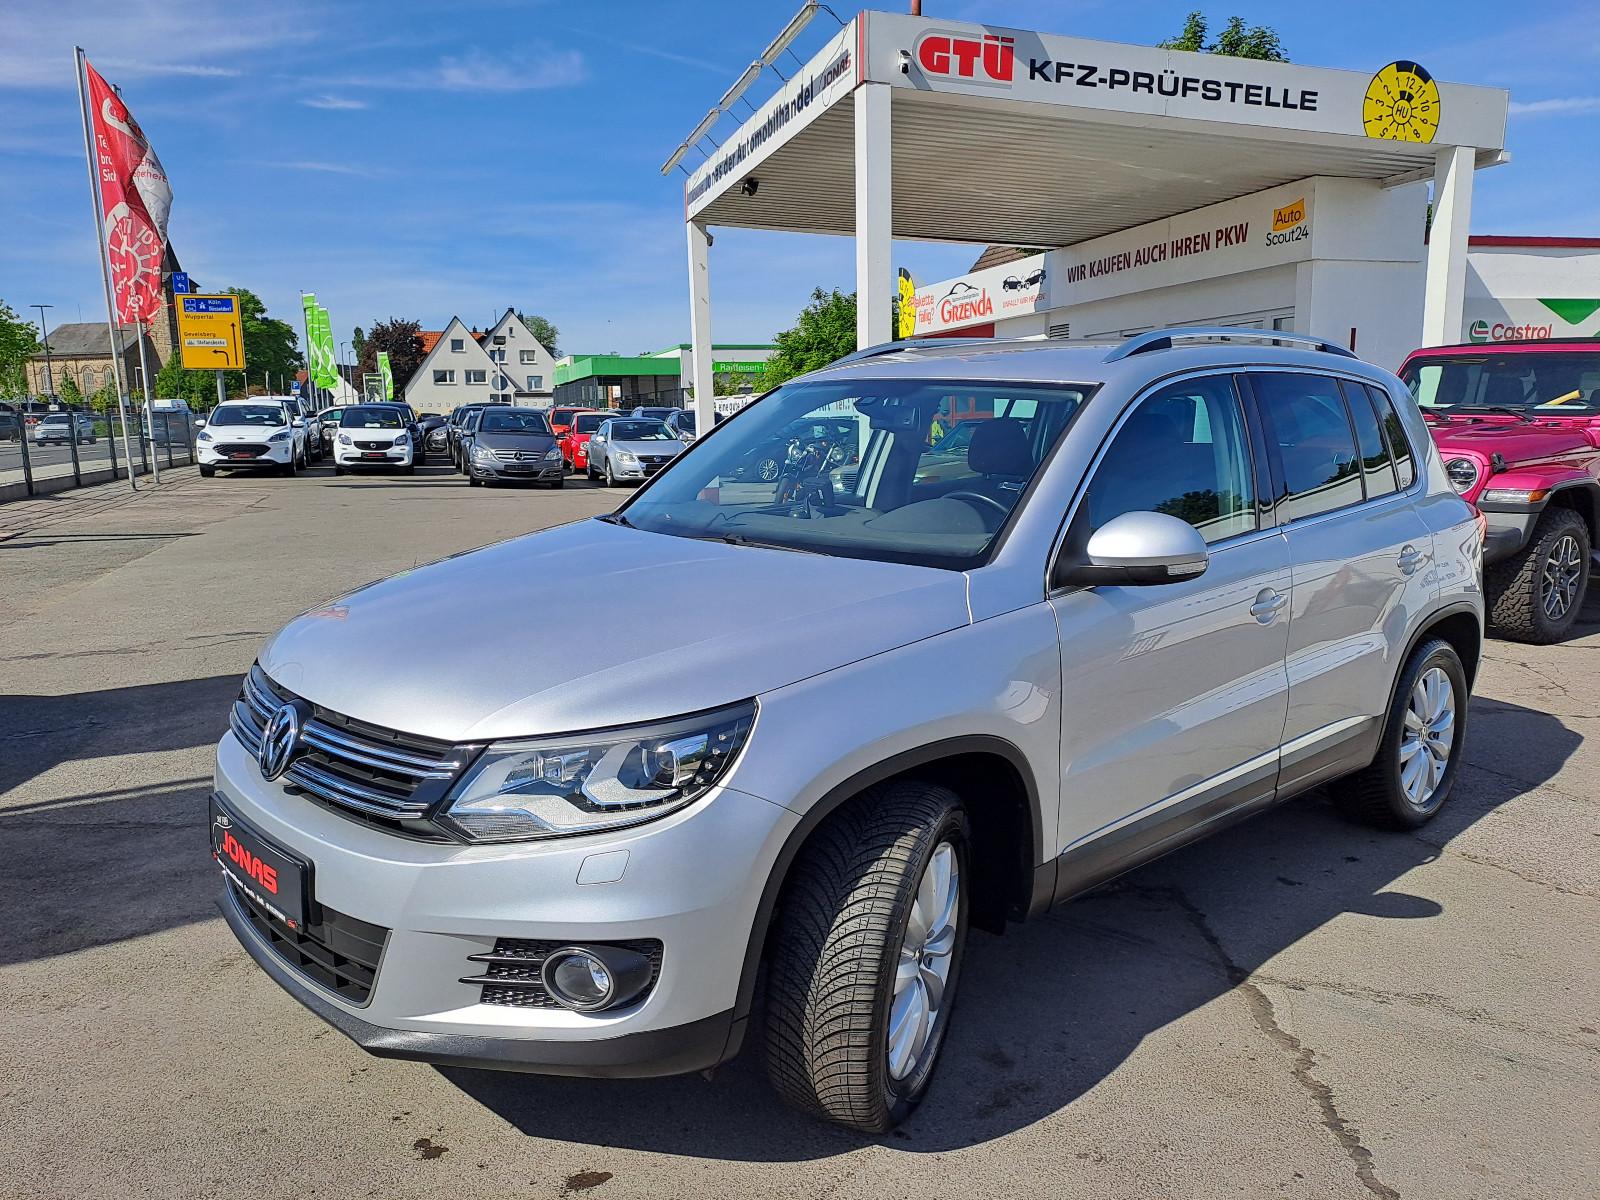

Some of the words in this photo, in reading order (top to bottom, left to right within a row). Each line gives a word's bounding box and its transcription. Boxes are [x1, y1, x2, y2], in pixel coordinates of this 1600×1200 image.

[919, 34, 1014, 82] GTÜ
[1029, 58, 1318, 112] KFZ-PRÜFSTELLE
[1396, 76, 1400, 88] 1
[1406, 76, 1416, 90] 12
[1383, 84, 1392, 96] 2
[1415, 85, 1426, 99] 11
[1375, 98, 1385, 107] 3
[1420, 99, 1430, 112] 10
[1374, 114, 1383, 122] 4
[1395, 104, 1409, 119] HU
[723, 152, 736, 176] der
[736, 73, 814, 166] Automobilhandel
[1380, 127, 1389, 138] 5
[1412, 128, 1421, 139] 8
[1274, 207, 1302, 226] Auto
[135, 225, 153, 244] 10
[1265, 224, 1309, 247] Scout24
[1067, 264, 1087, 284] WIR
[1089, 251, 1131, 278] KAUFEN
[1134, 242, 1167, 268] AUCH
[1170, 232, 1211, 260] IHREN
[1215, 222, 1249, 250] PKW
[1491, 323, 1553, 340] Castrol
[222, 829, 279, 896] JONAS
